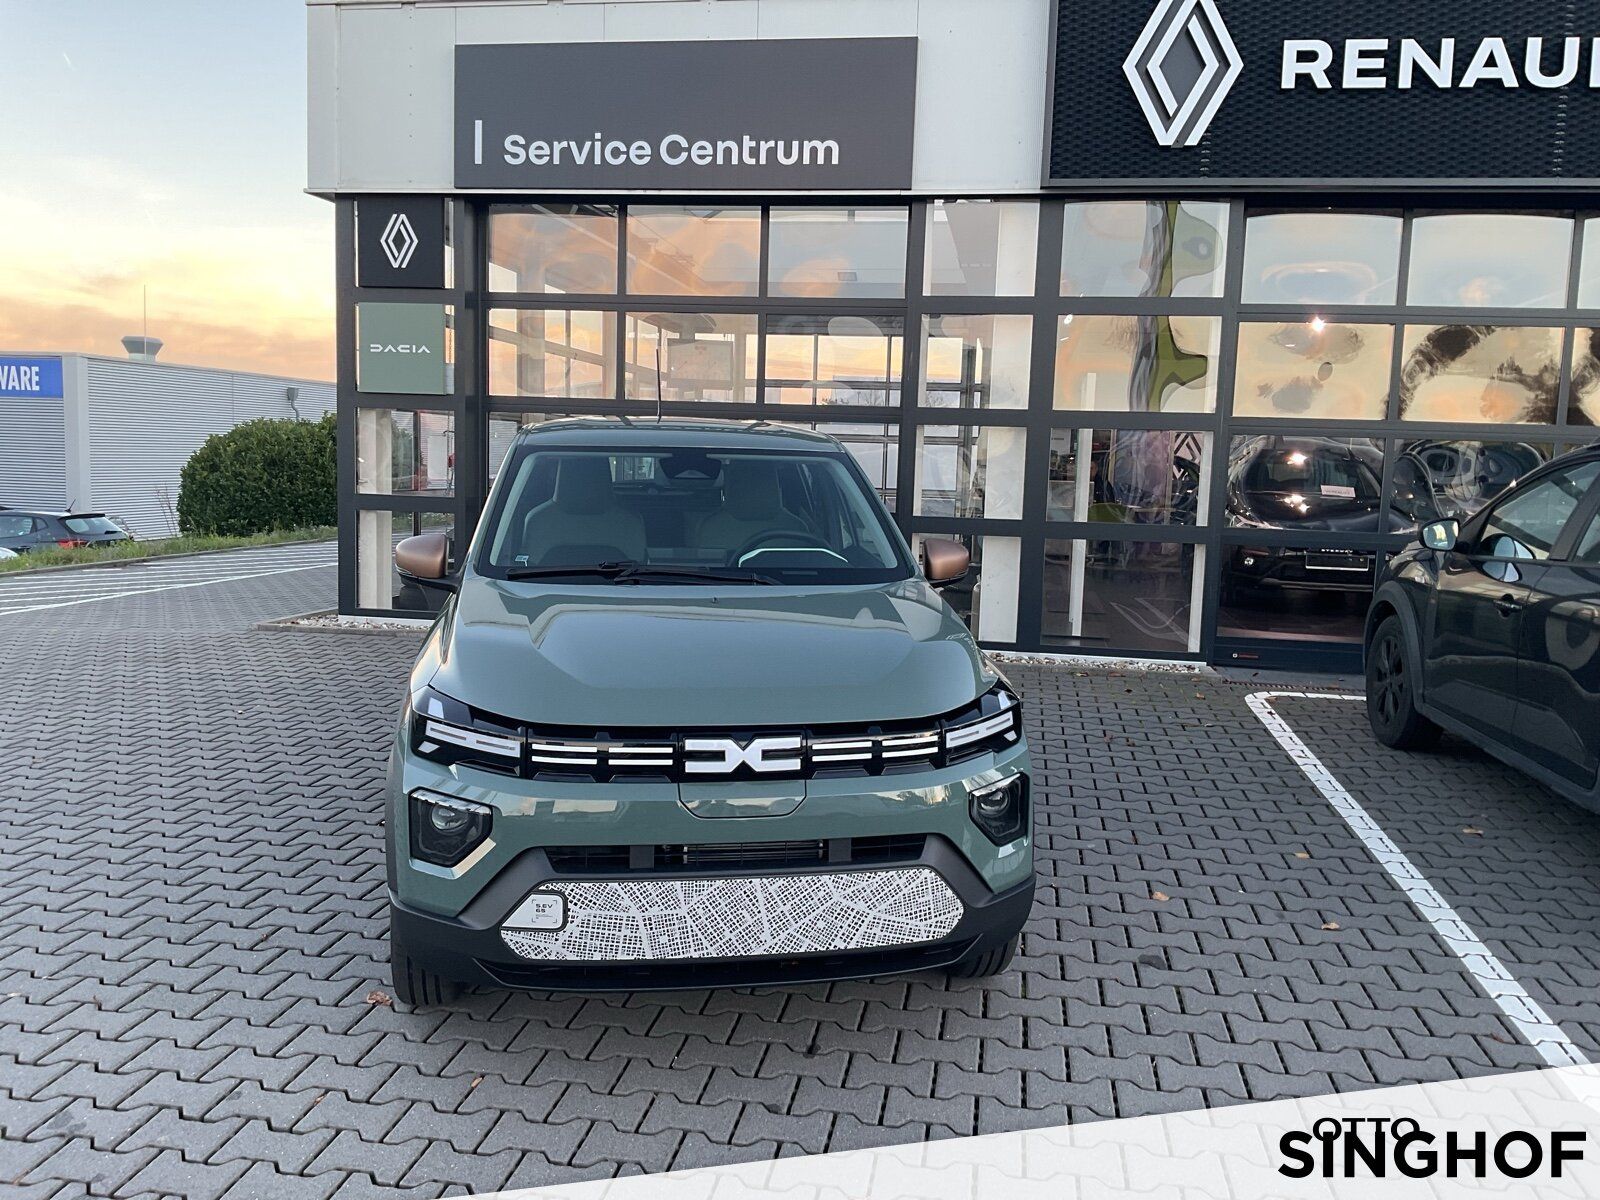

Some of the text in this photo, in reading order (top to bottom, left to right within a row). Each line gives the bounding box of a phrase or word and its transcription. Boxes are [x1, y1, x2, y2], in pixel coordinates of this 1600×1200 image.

[1280, 37, 1600, 89] RENAU
[504, 132, 839, 166] Service Centrum
[370, 344, 431, 353] DACIA
